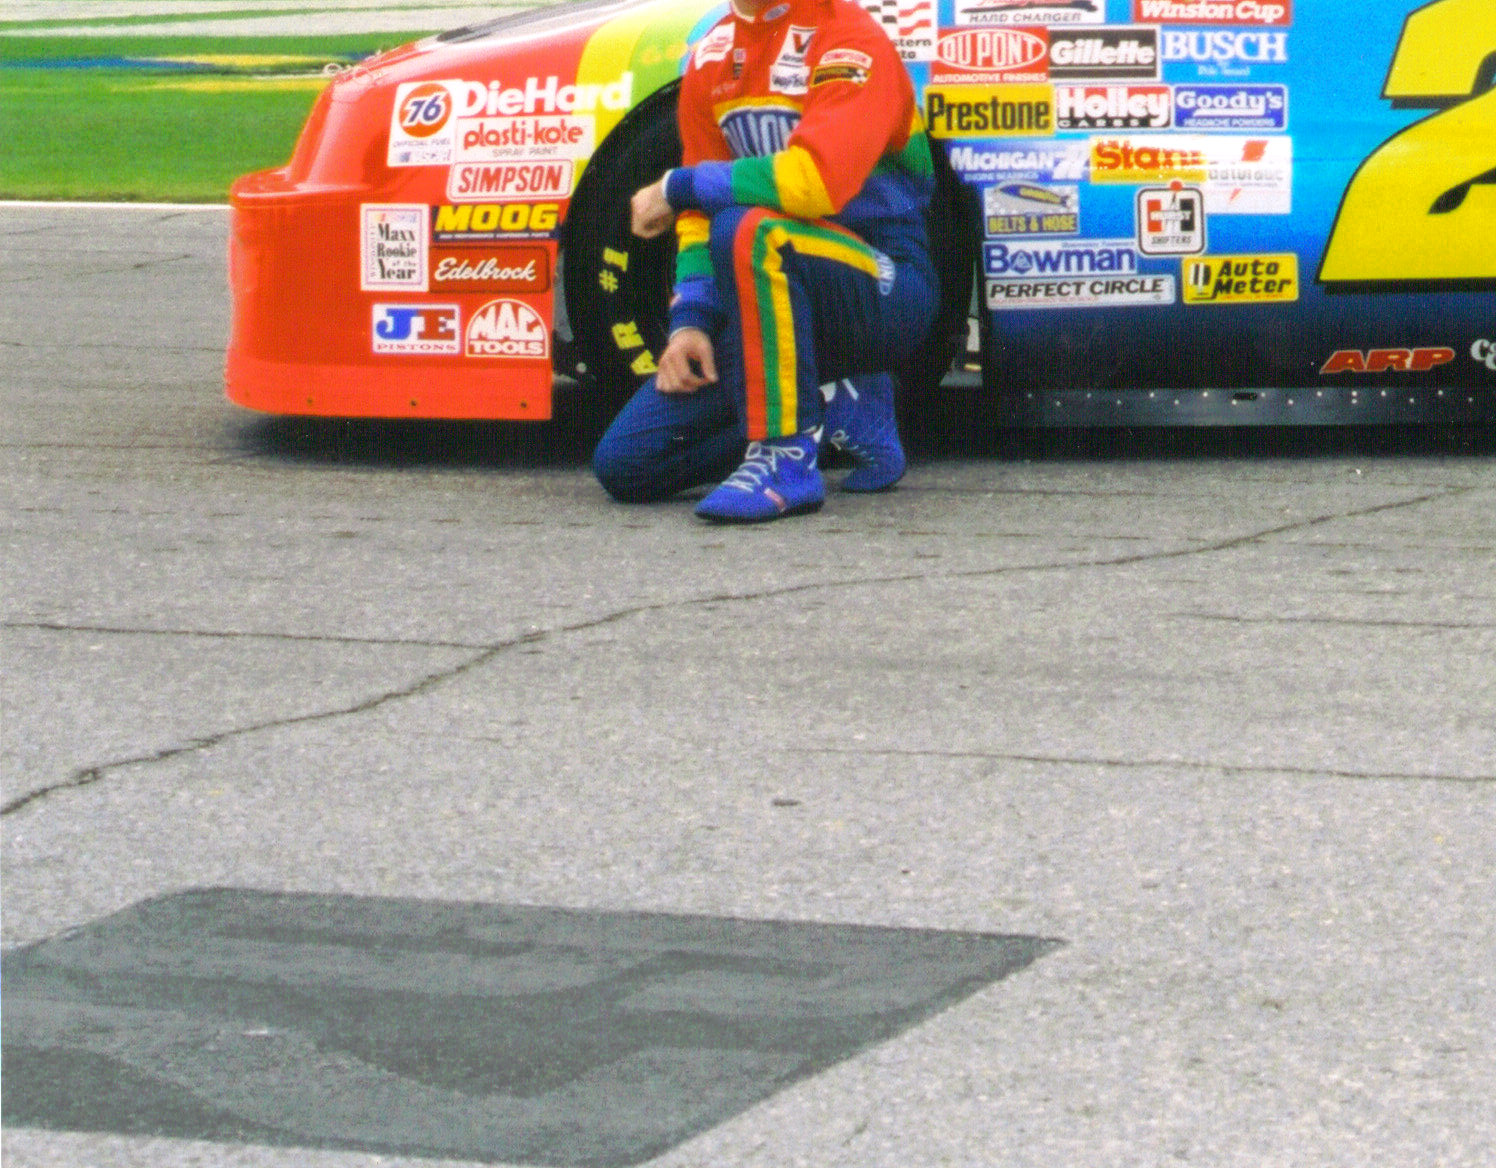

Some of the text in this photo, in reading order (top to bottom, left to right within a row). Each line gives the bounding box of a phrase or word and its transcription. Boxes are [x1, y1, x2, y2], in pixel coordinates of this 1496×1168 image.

[969, 12, 1081, 23] HARD CHARGER
[1141, 0, 1284, 24] Winston Cup
[1050, 39, 1155, 65] Gillette
[1163, 31, 1287, 61] BUSCH
[457, 73, 633, 117] DieHard
[1058, 87, 1170, 127] Holley
[1176, 91, 1283, 116] Goody's
[406, 93, 444, 124] 76
[928, 93, 1049, 131] Prestone
[463, 119, 583, 150] plasti-kote
[458, 165, 562, 193] SIMPSON
[434, 204, 559, 231] MOOG
[377, 223, 415, 241] Maxx
[377, 243, 417, 257] Rookie
[378, 258, 416, 279] Year
[434, 257, 536, 282] Edelbrock
[599, 247, 628, 293] #1
[1218, 259, 1279, 277] Auto
[990, 278, 1164, 298] PERFECT CIRCLE
[1213, 277, 1292, 297] Meter
[376, 308, 455, 340] JE
[471, 302, 543, 340] MAC
[376, 343, 456, 351] PISTONS
[470, 340, 543, 355] TOOLS
[1319, 347, 1455, 373] ARP
